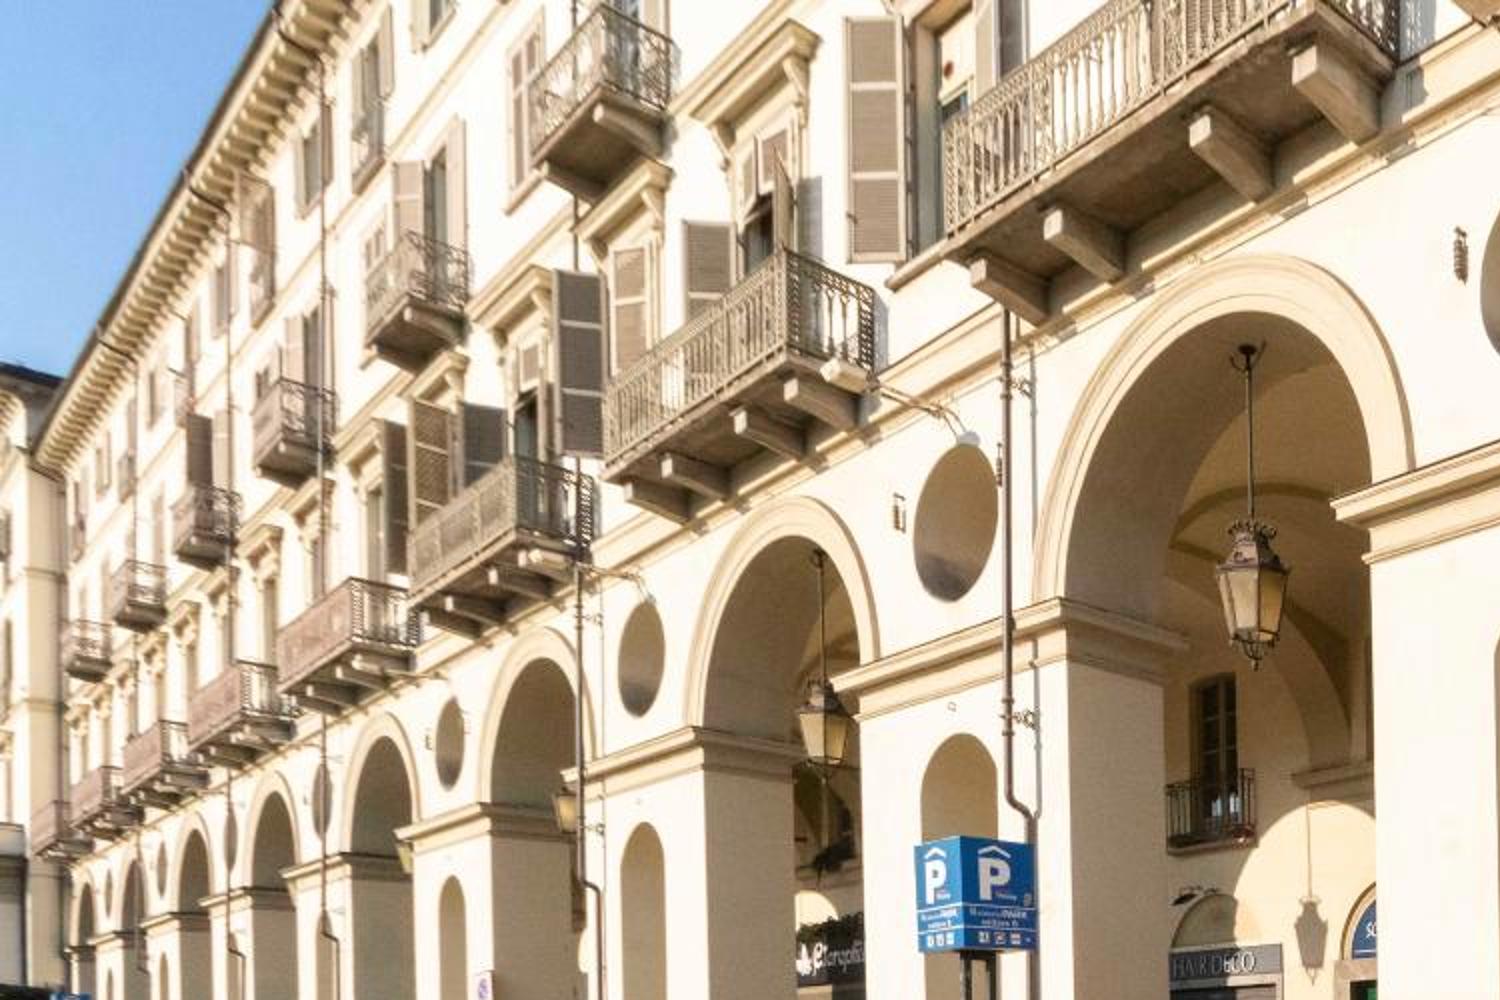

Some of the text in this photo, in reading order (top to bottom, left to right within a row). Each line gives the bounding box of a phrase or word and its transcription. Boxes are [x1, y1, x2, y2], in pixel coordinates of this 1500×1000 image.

[926, 860, 946, 904] P
[977, 857, 1011, 901] P
[1212, 951, 1256, 975] DECO
